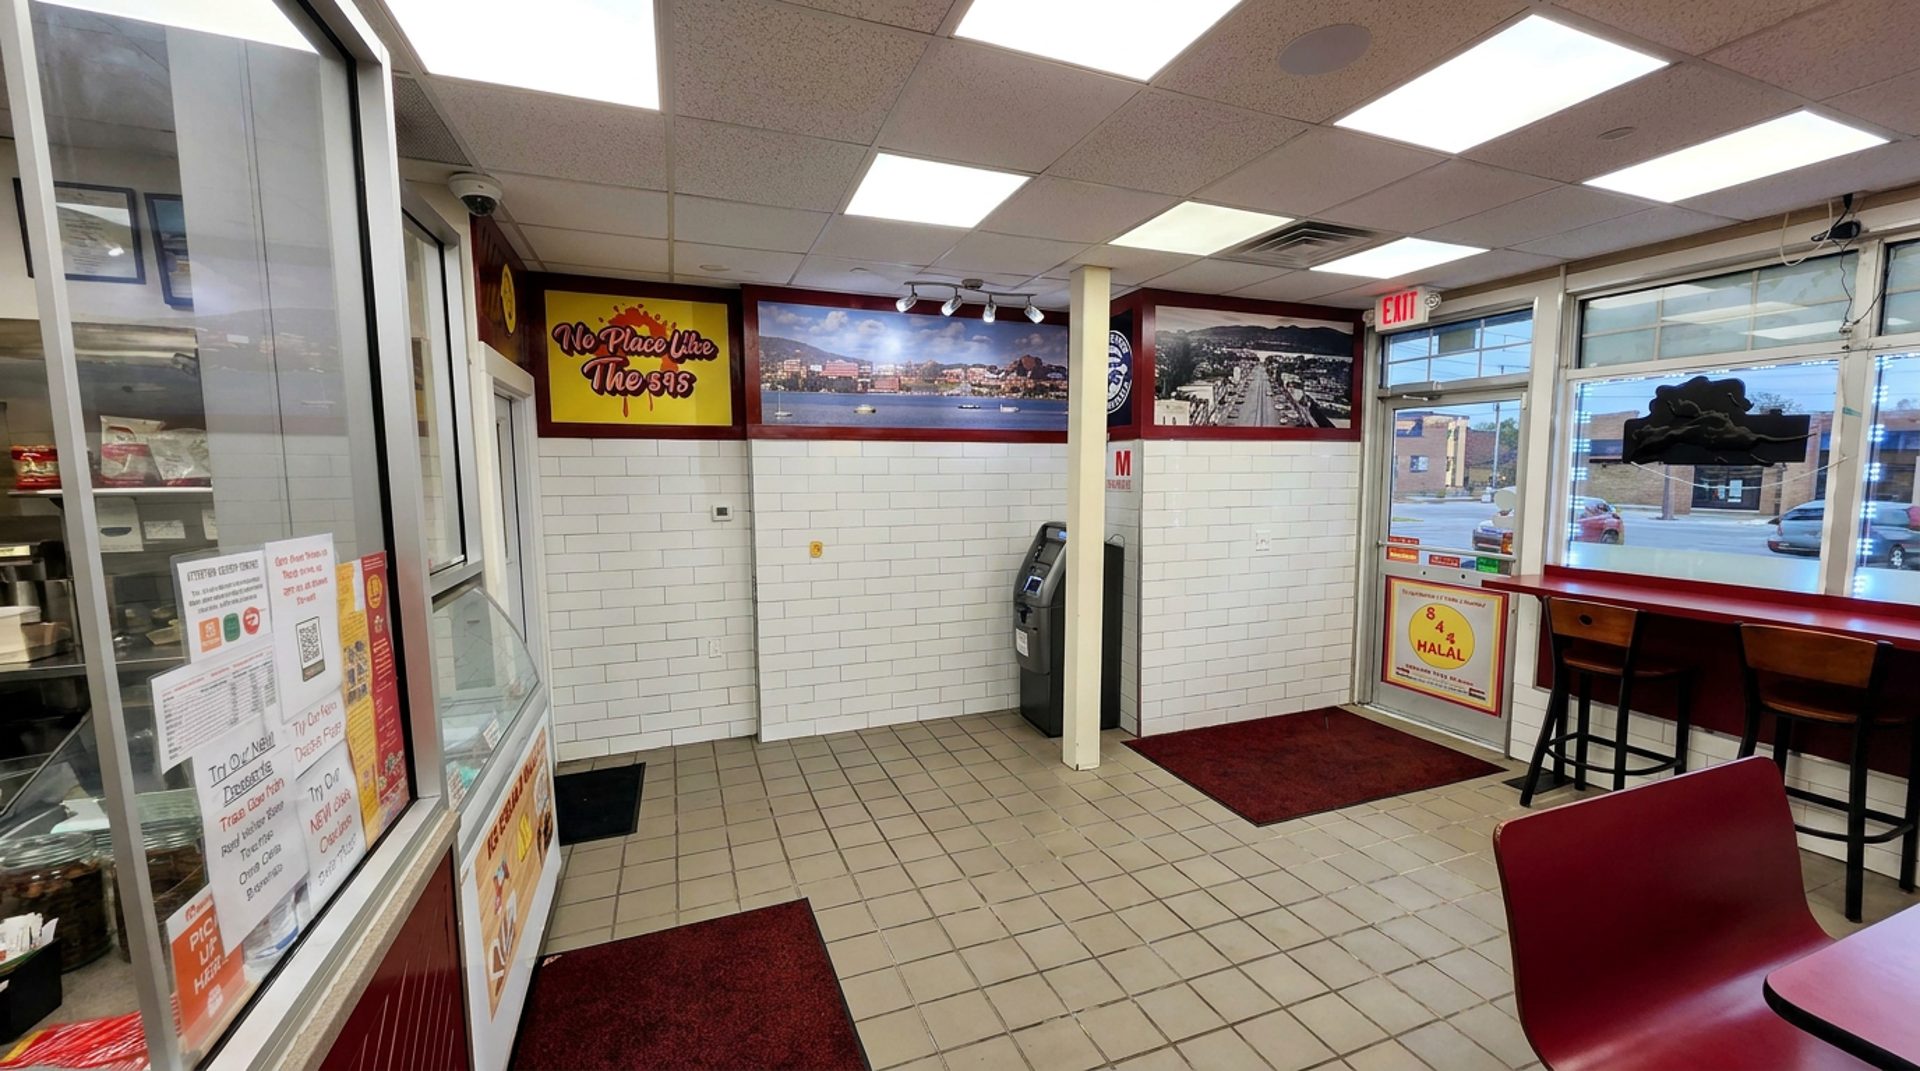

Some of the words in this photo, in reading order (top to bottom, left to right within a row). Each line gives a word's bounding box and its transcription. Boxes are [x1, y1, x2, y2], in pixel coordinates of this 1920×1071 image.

[1383, 291, 1418, 324] EXIT
[553, 322, 597, 354] No
[600, 326, 668, 355] Place
[669, 331, 717, 360] Like
[582, 356, 644, 394] The
[1417, 639, 1466, 662] HALAL
